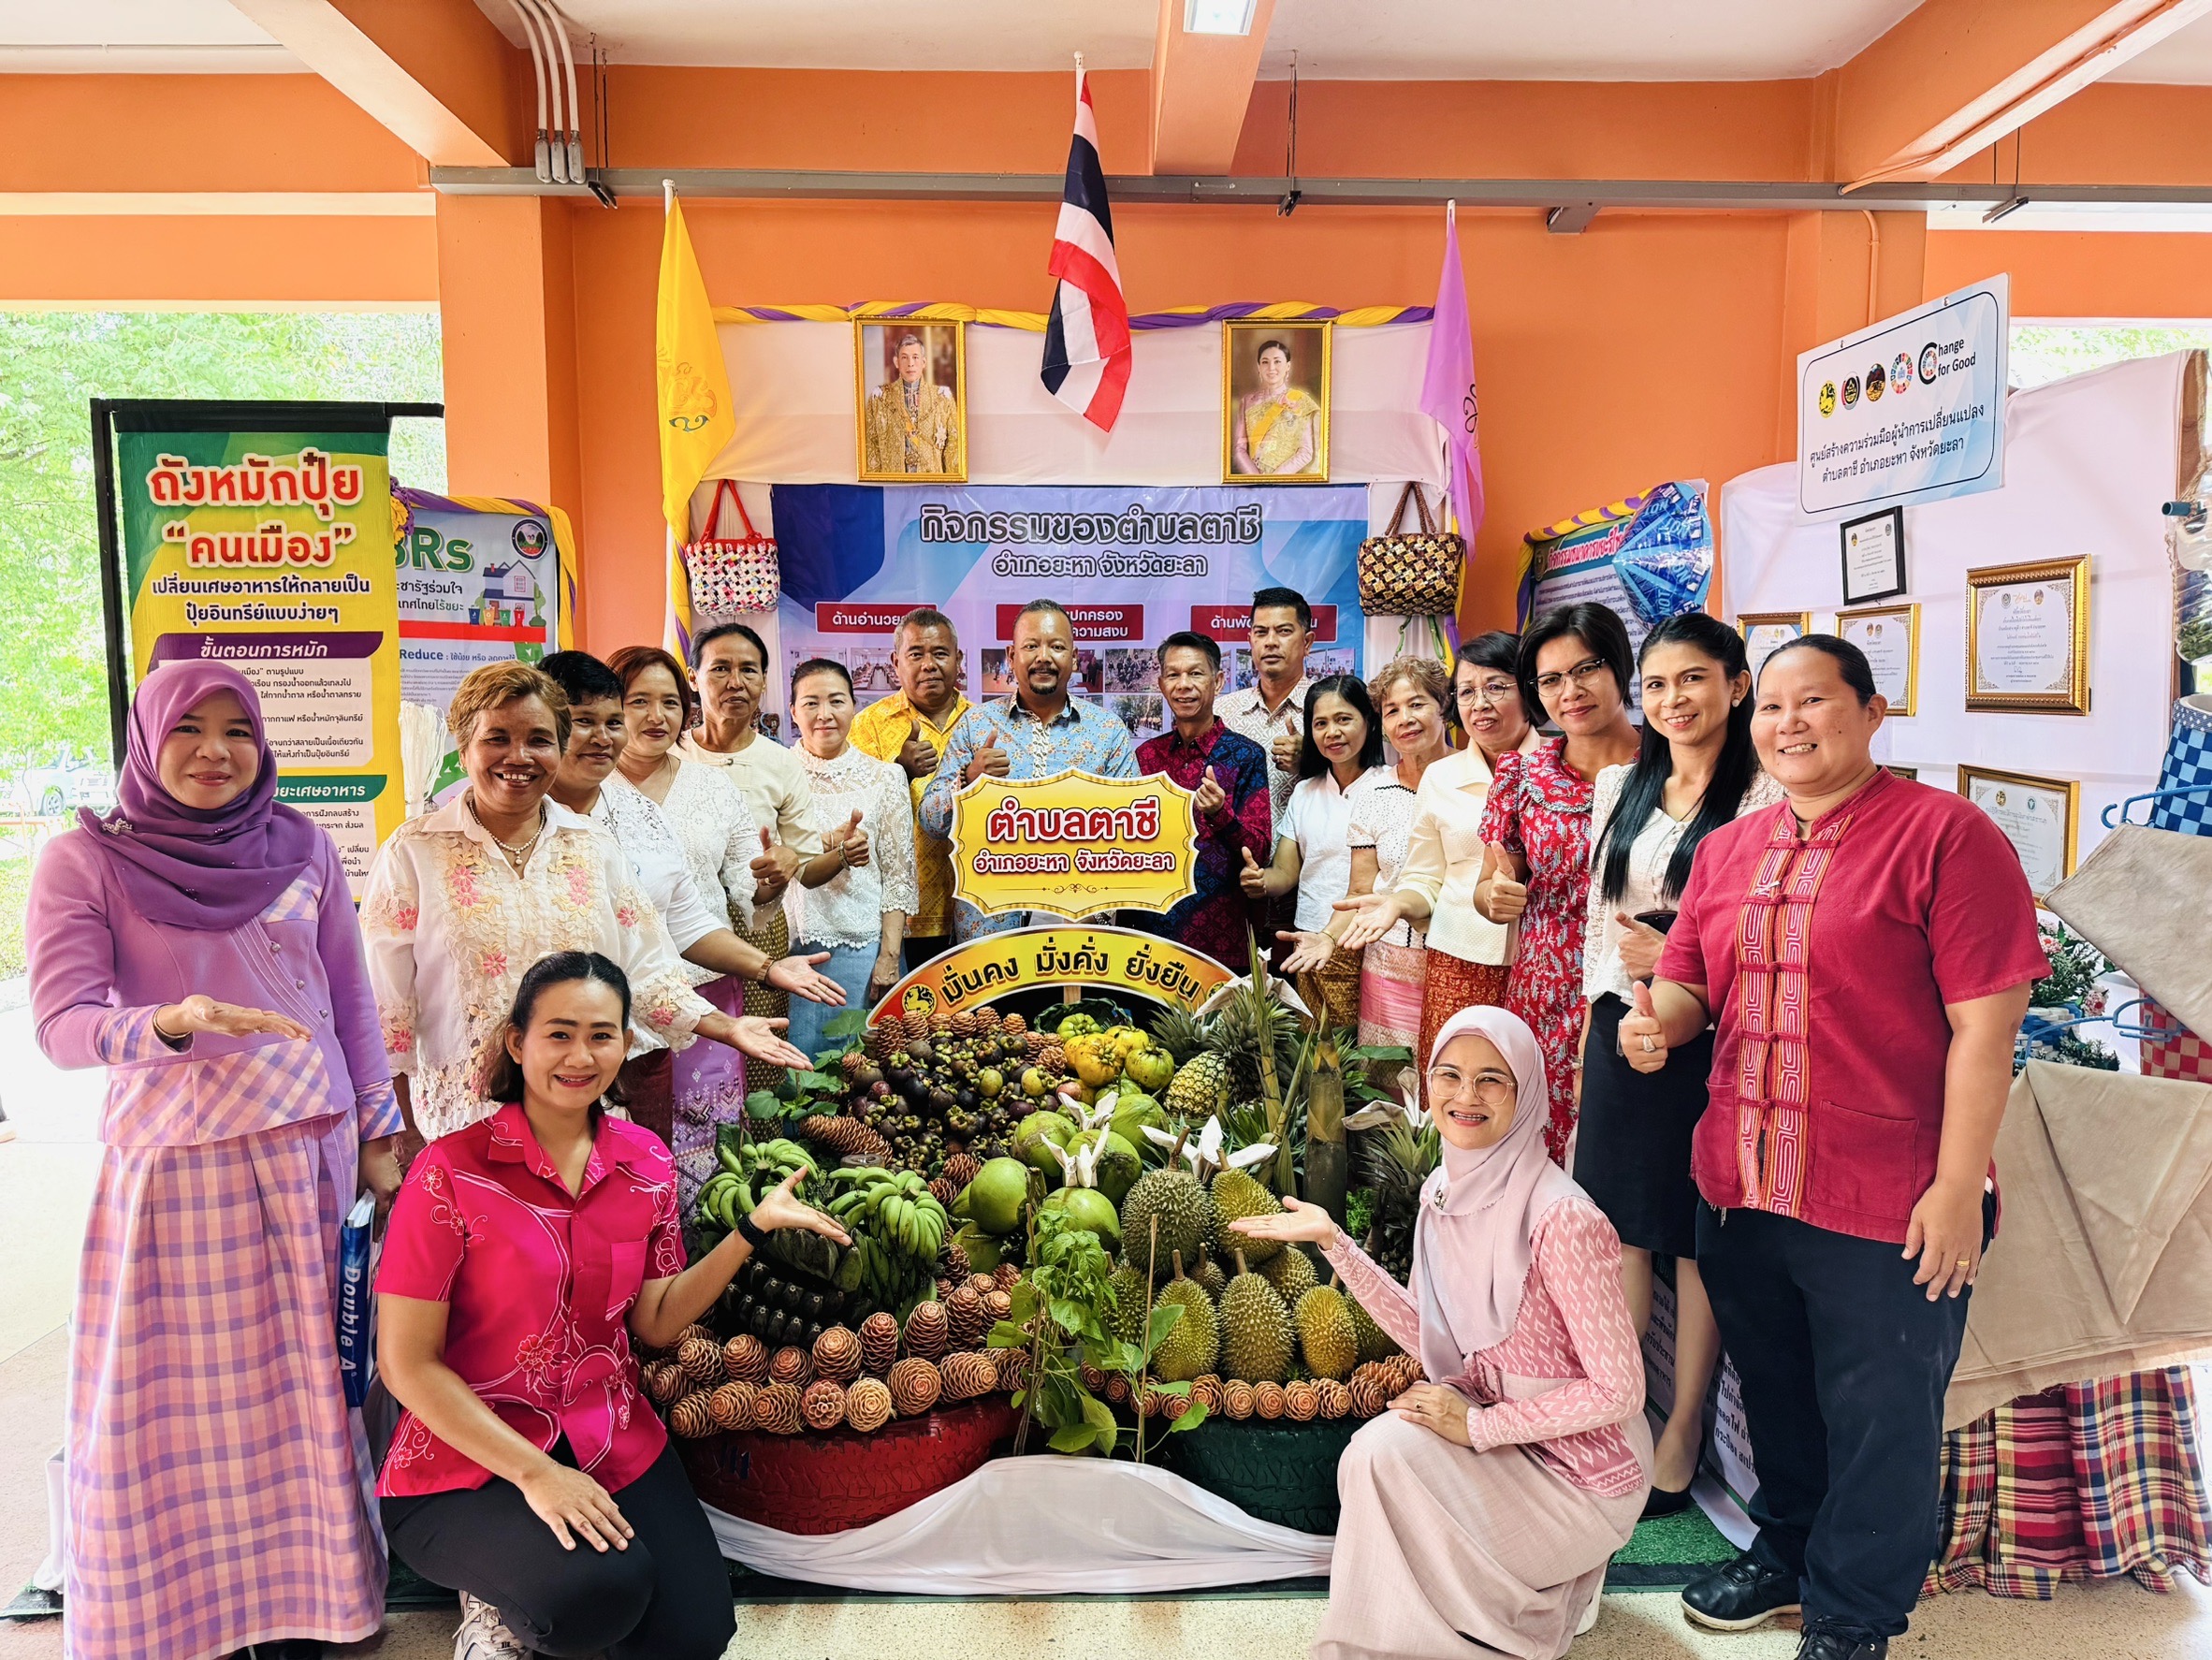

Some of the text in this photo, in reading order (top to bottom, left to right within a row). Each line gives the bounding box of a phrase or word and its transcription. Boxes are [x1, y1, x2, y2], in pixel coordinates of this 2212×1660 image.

[1938, 352, 1976, 378] for Good
[1811, 404, 1984, 468] ศูนย์สร้างความร่วมมือผู้นำการเปลี่ยนแปลง
[1822, 436, 1964, 483] ตำบลตาชี อำเภอยะหา จังหวัดยะลา
[150, 451, 361, 518] ถังหมักปุ๋ย
[921, 504, 1262, 544] กิจกรรมของตำบลตาชี
[993, 551, 1207, 576] อำเภอยะหา จังหวัดยะลา
[153, 575, 370, 595] เปลี่ยนเศษอาหารให้กลายเป็น
[186, 601, 340, 626] ปุ๋ยอินทรีย์แบบง่ายๆ
[832, 610, 905, 626] ด้านอำนวย
[200, 636, 327, 658] ขั้นตอนการหมัก
[400, 648, 444, 661] Reduce
[988, 796, 1160, 841] ตำบลตาชี
[974, 848, 1176, 874] อำเภอยะหา จังหวัดยะลา
[939, 937, 1201, 1005] มั่นคง มั่งคั่ง ยั่งยืน
[340, 1267, 361, 1371] Double A
